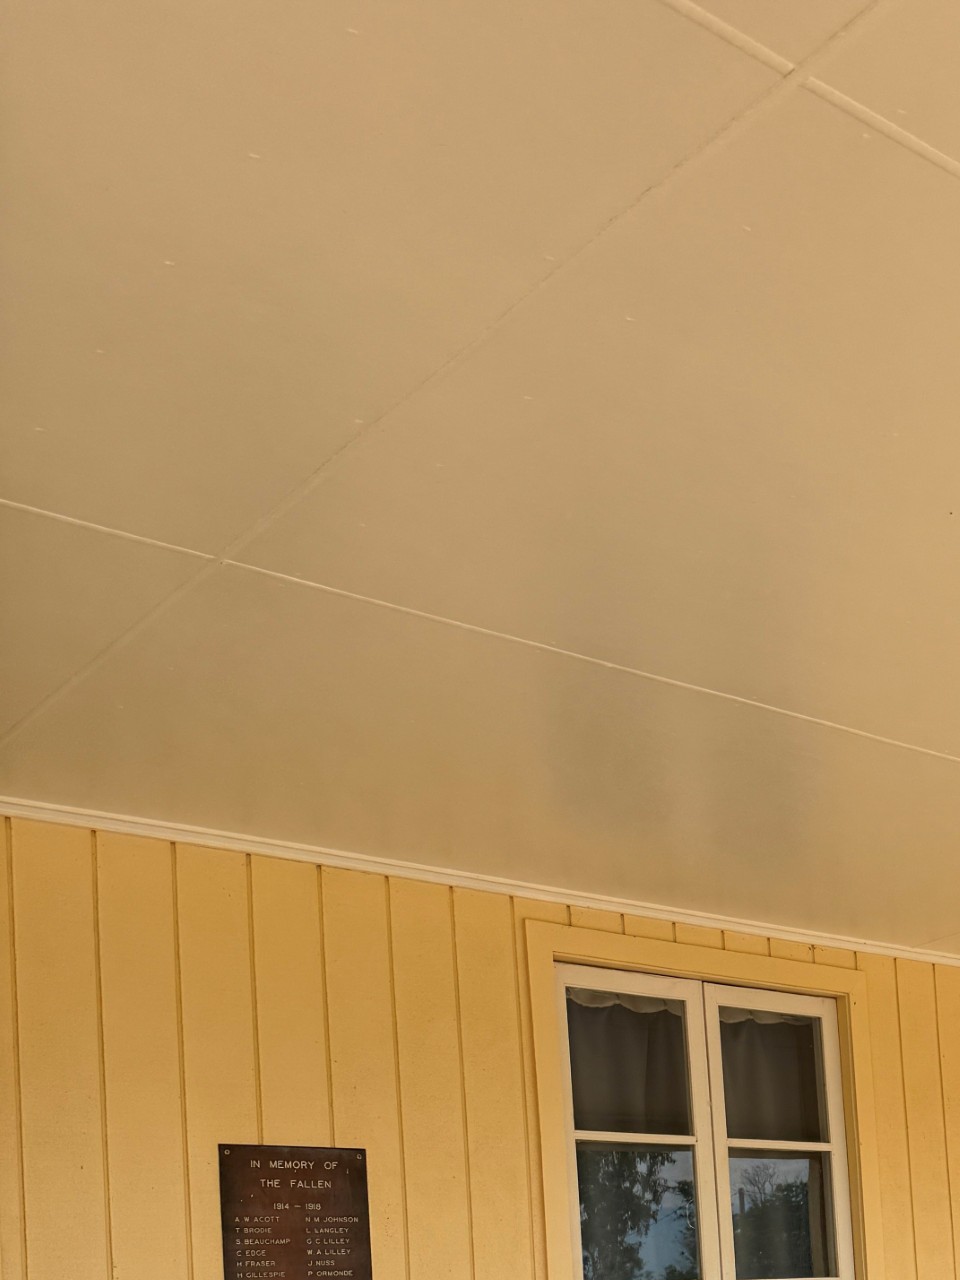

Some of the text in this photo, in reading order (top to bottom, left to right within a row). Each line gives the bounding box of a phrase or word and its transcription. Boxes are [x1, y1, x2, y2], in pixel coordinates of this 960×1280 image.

[250, 1159, 339, 1170] IN MEMORY OF
[260, 1179, 332, 1189] THE FALLEN
[273, 1202, 290, 1210] 1914
[305, 1203, 322, 1211] 1918
[324, 1248, 351, 1256] LILLEY
